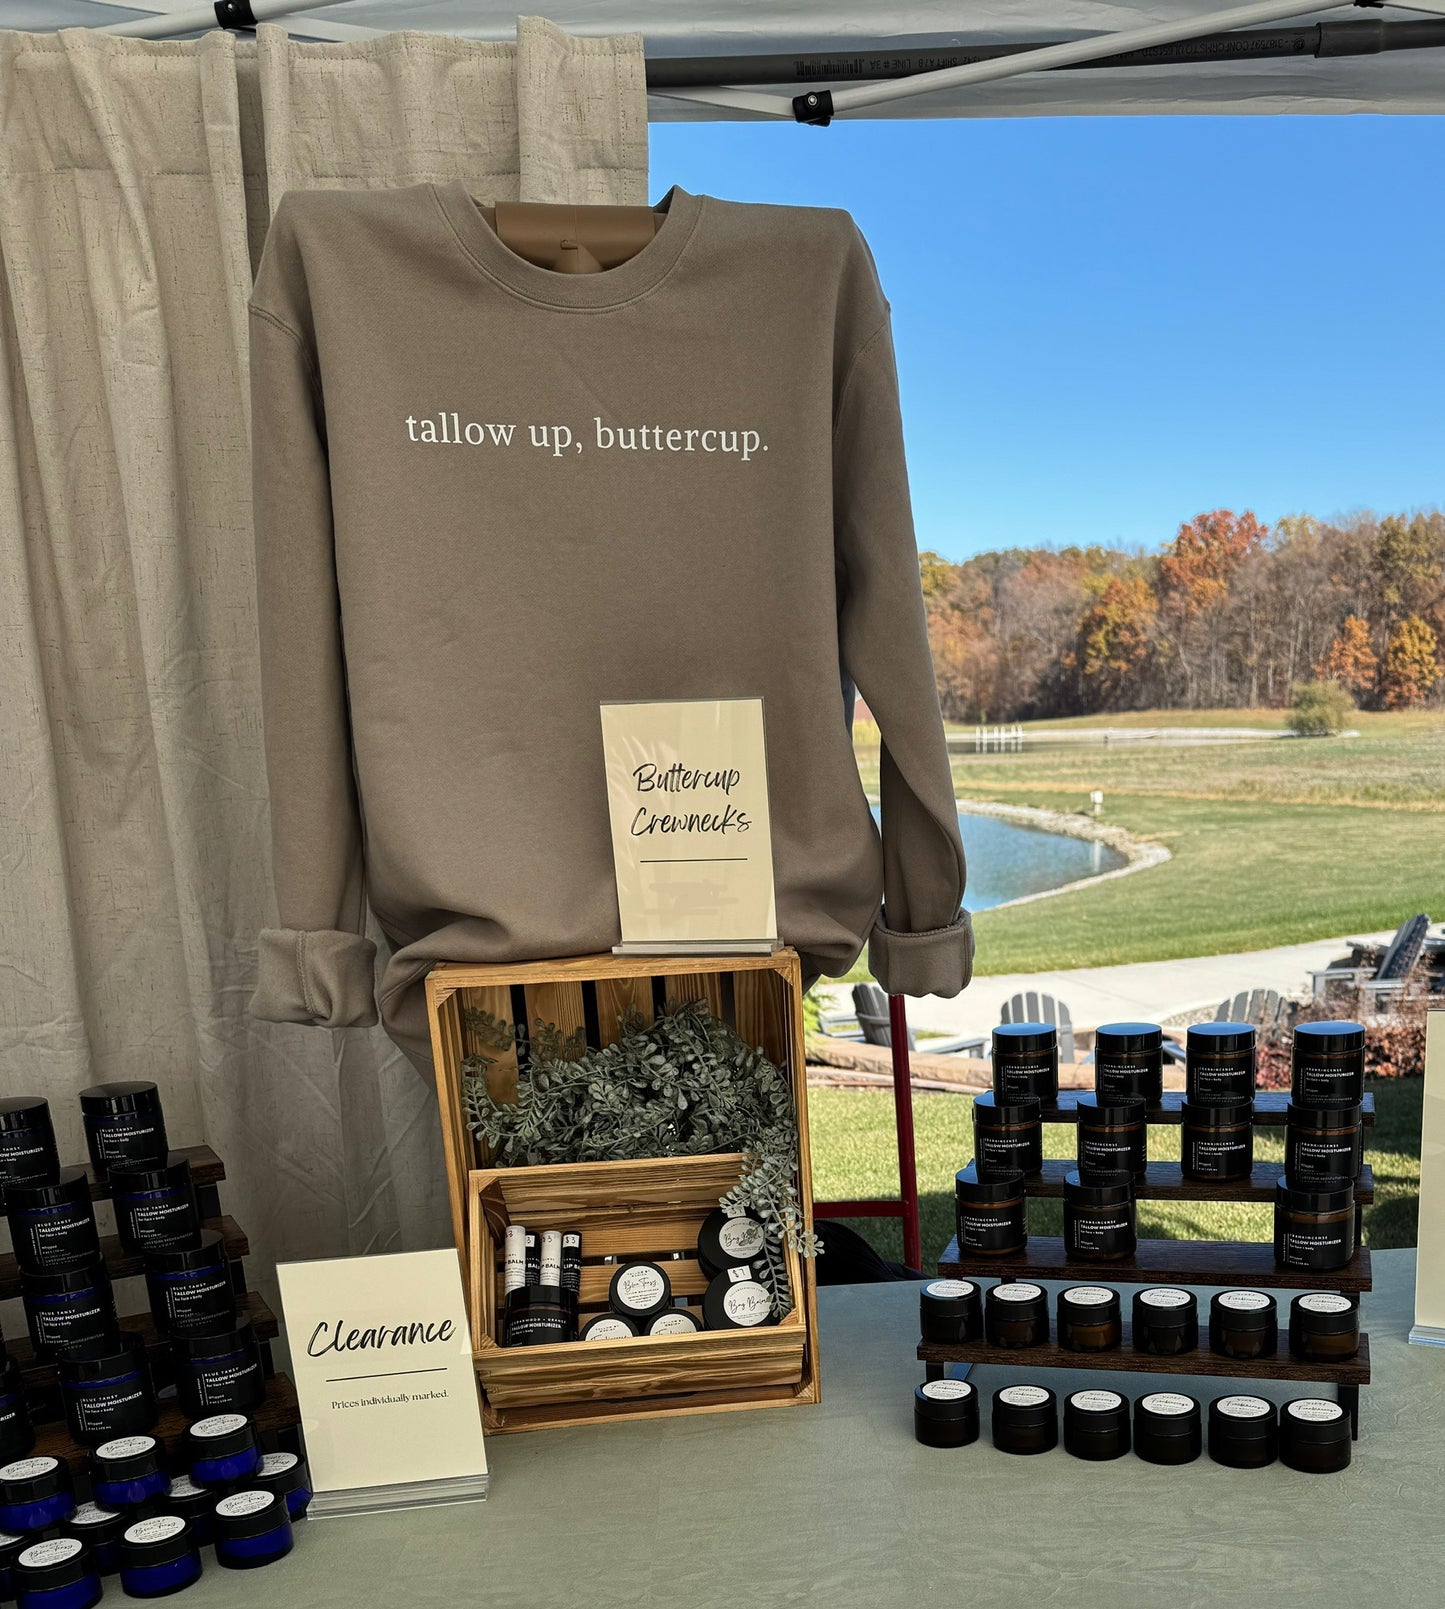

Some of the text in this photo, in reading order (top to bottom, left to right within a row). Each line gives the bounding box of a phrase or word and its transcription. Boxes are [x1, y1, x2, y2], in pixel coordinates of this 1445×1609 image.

[869, 59, 882, 70] 3A
[893, 59, 911, 71] LINE
[405, 411, 769, 461] tallow up, buttercup.
[632, 762, 740, 796] Buttercup
[630, 804, 752, 837] Crewnecks
[122, 1127, 155, 1138] MOISTURIZER
[10, 1146, 44, 1157] MOISTURIZER
[158, 1203, 189, 1215] MOISTURIZER
[39, 1217, 90, 1233] TALLOW MOISTURIZER
[564, 1235, 577, 1244] $3
[1309, 1238, 1342, 1246] MOISTURIZER
[563, 1262, 573, 1270] LIP
[732, 1267, 747, 1279] $7
[196, 1280, 227, 1293] MOISTURIZER
[64, 1307, 101, 1320] MOISTURIZER
[307, 1319, 456, 1358] Clearance
[228, 1362, 258, 1379] MOISTURIZER
[106, 1390, 143, 1407] MOISTURIZER
[331, 1389, 450, 1409] Prices individually marked.
